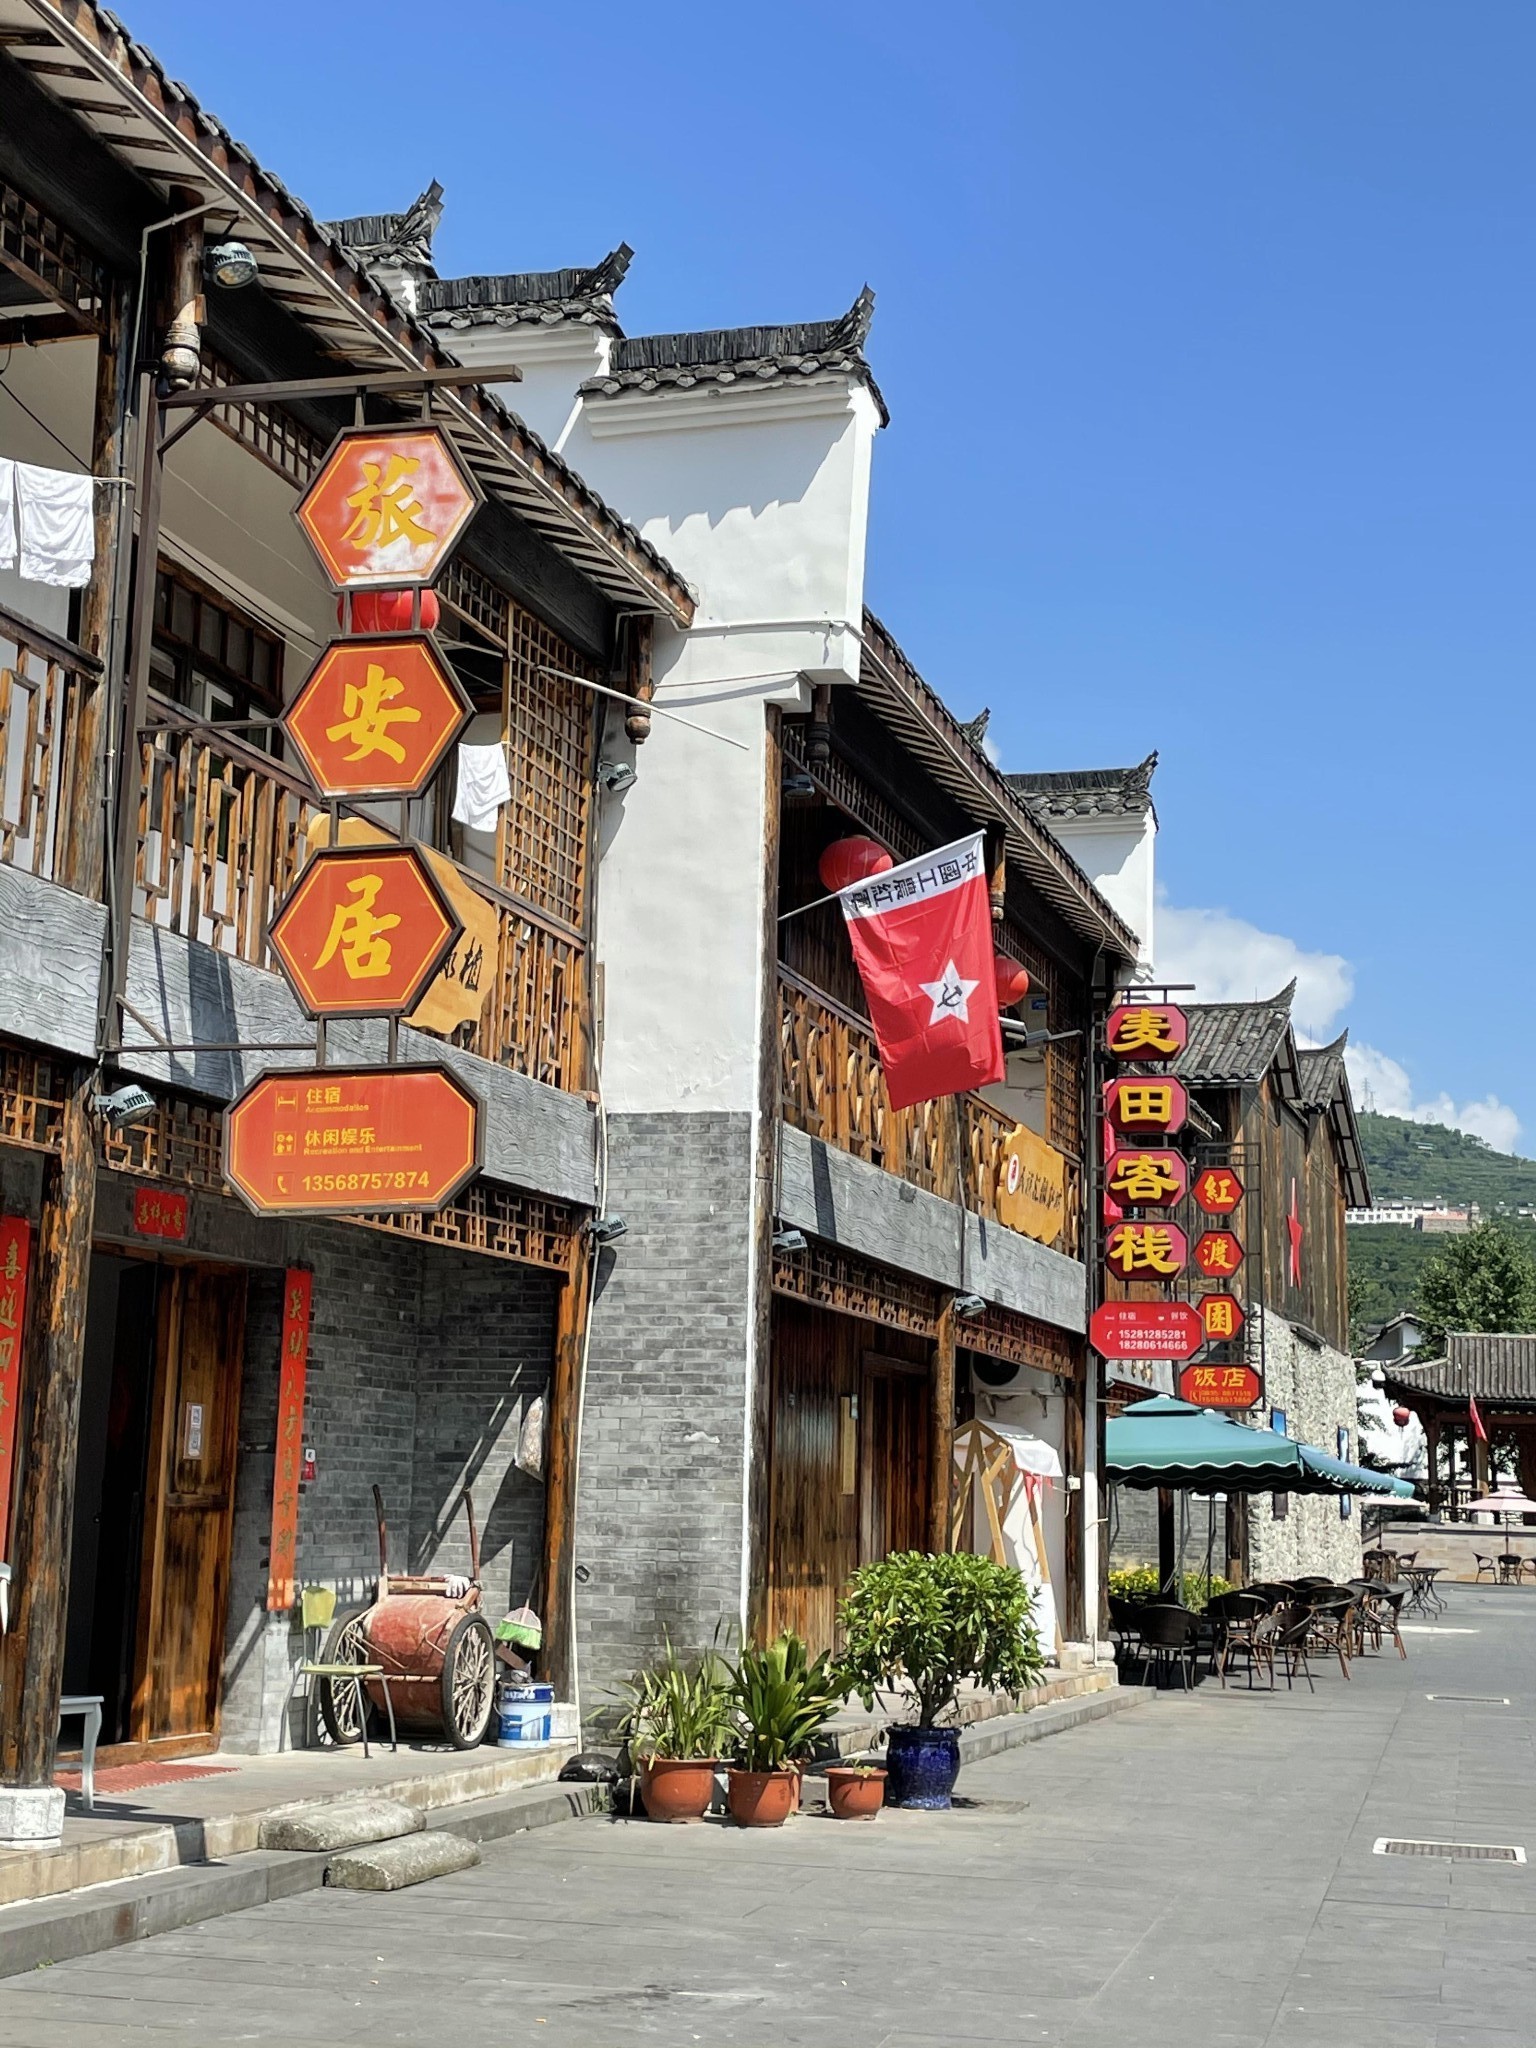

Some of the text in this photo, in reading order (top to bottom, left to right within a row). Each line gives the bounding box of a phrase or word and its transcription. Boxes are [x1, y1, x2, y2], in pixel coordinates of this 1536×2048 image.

[313, 453, 437, 980] 旅安居
[851, 852, 977, 911] 中國工農紅軍
[306, 1087, 341, 1104] 住宿
[305, 1127, 376, 1146] 休闲娱乐
[1110, 1009, 1181, 1274] 麦田客栈
[304, 1145, 348, 1155] Recreation
[302, 1171, 430, 1191] 13568757874
[1119, 1330, 1186, 1340] 15281285281
[1119, 1341, 1188, 1350] 18280614666
[1193, 1367, 1246, 1387] 饭店
